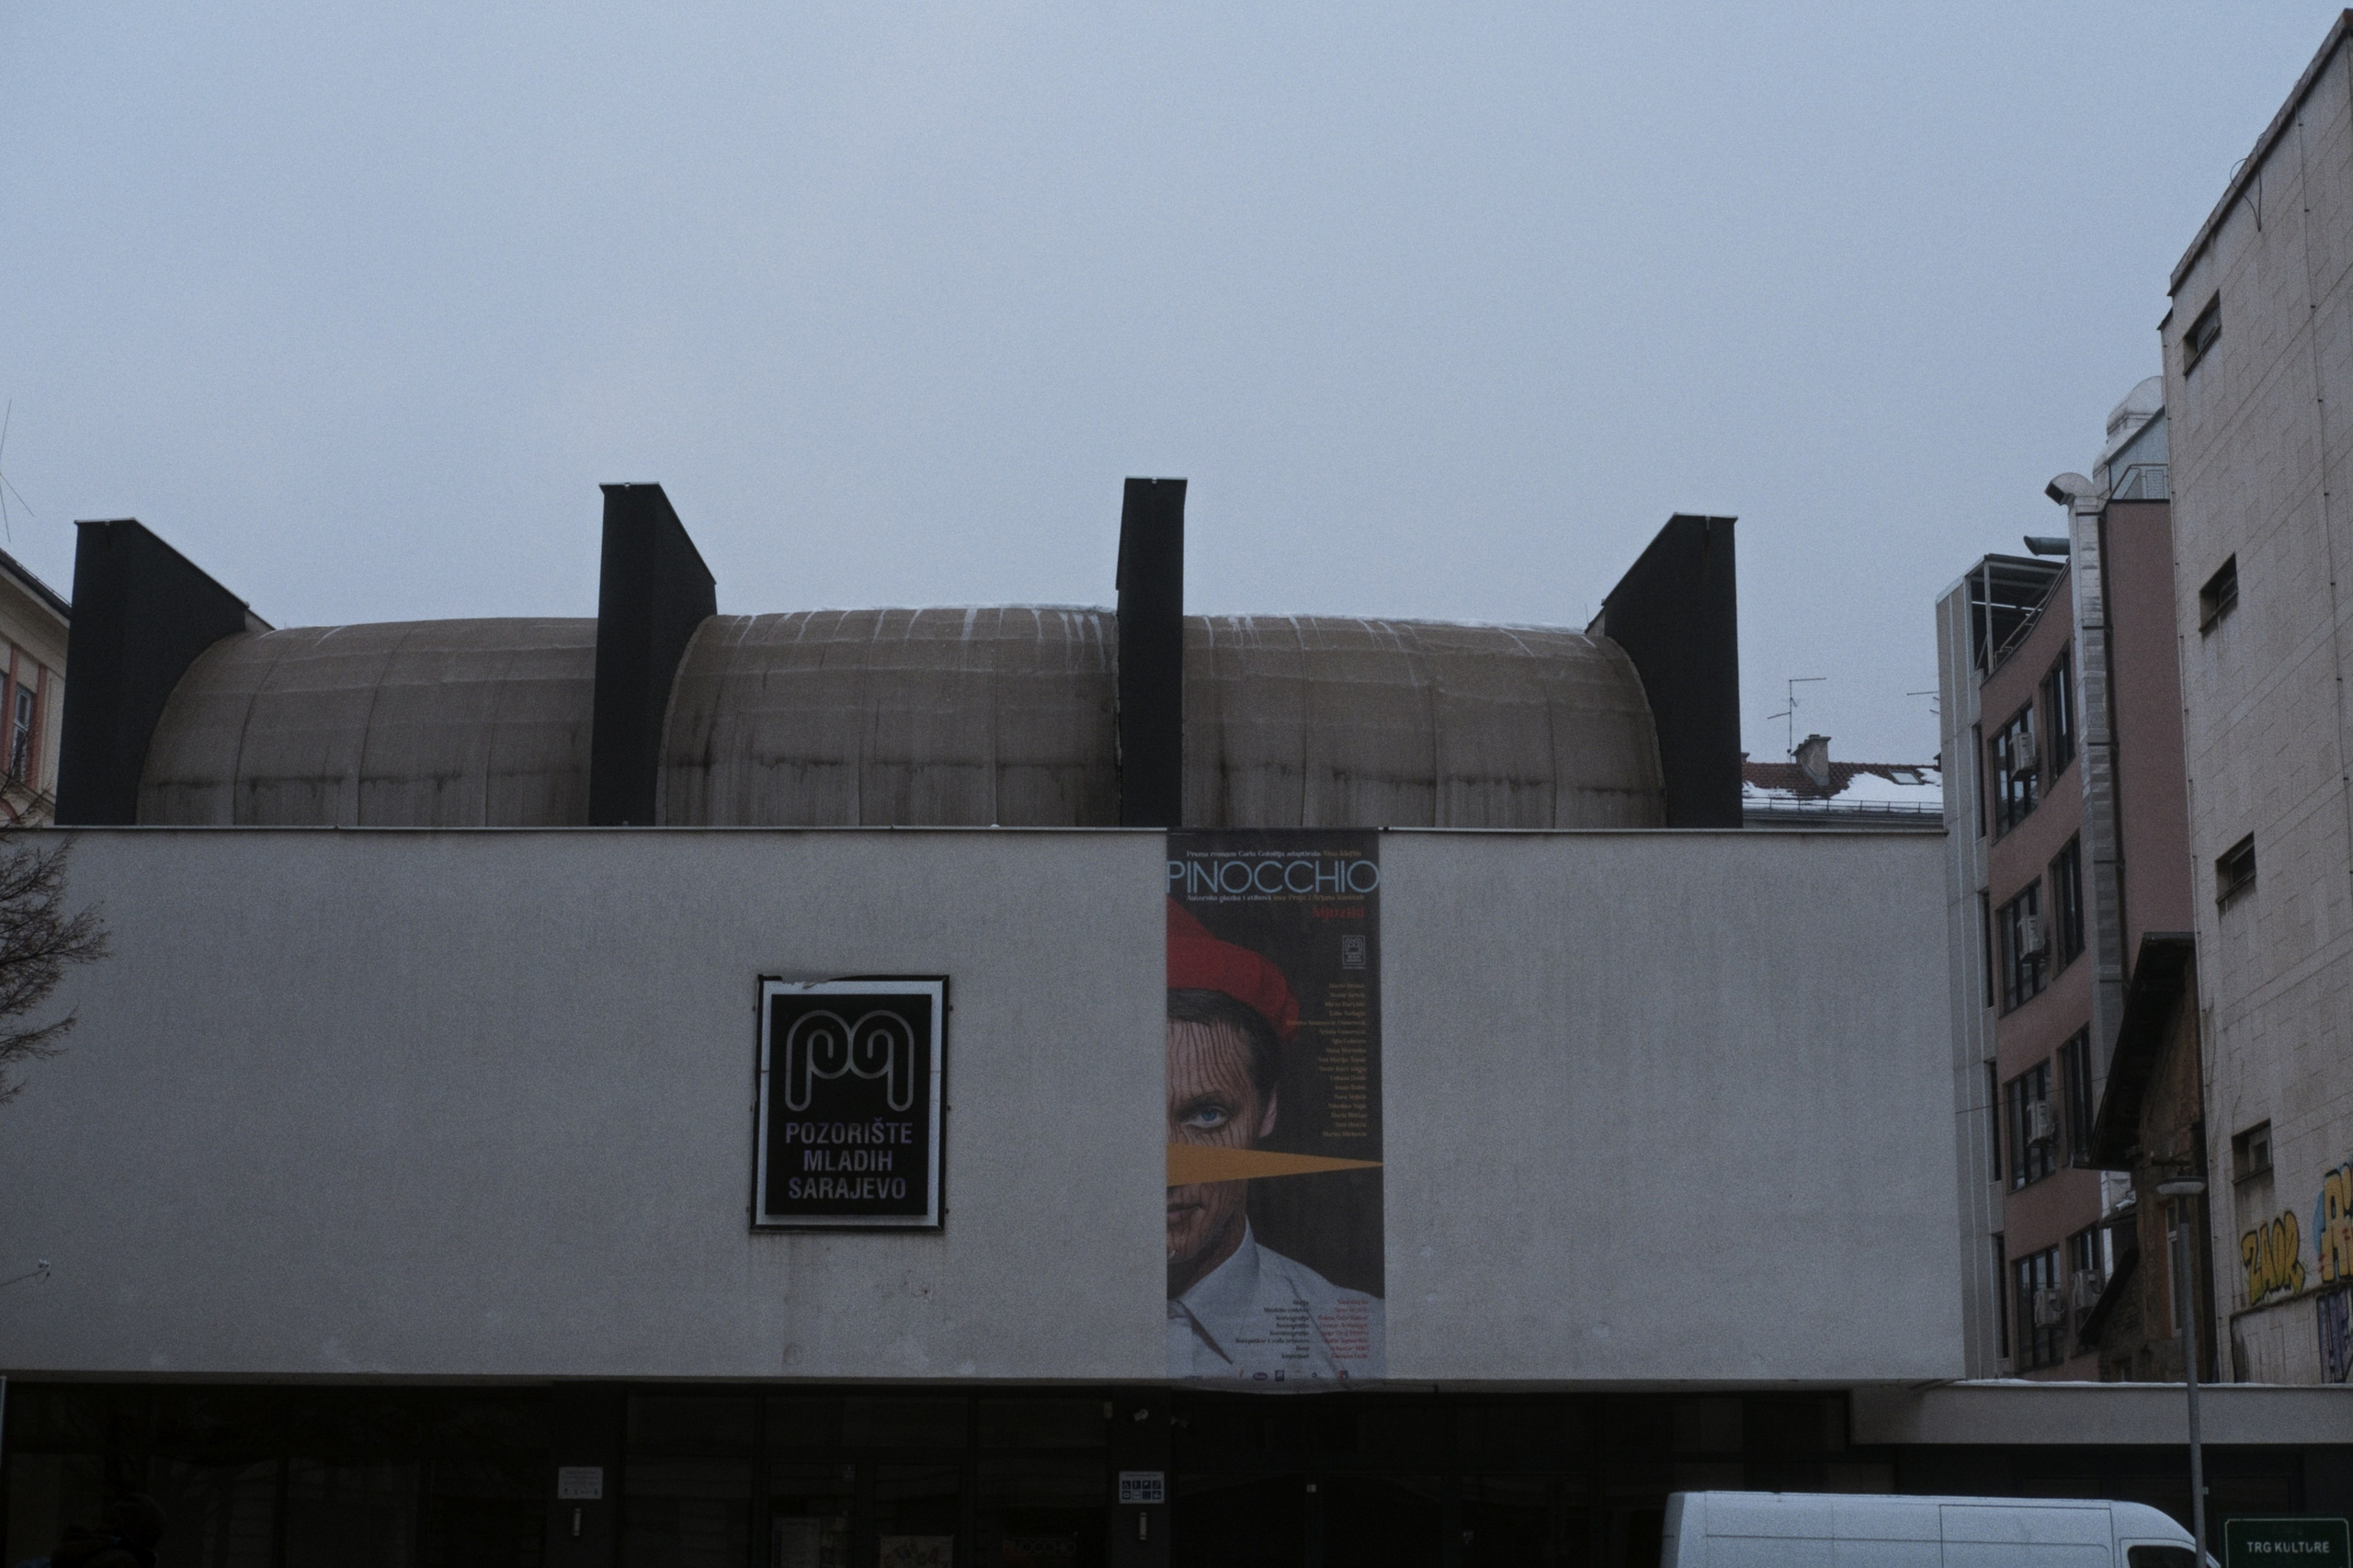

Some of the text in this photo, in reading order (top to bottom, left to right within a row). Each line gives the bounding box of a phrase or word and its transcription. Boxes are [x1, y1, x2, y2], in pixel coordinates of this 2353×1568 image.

[1165, 859, 1381, 893] PINOCCHIO
[785, 1117, 913, 1145] POZORIŠTE
[802, 1149, 893, 1172] MLADIH
[788, 1176, 907, 1200] SARAJEVO
[2246, 1540, 2330, 1554] TRG KULTURE
